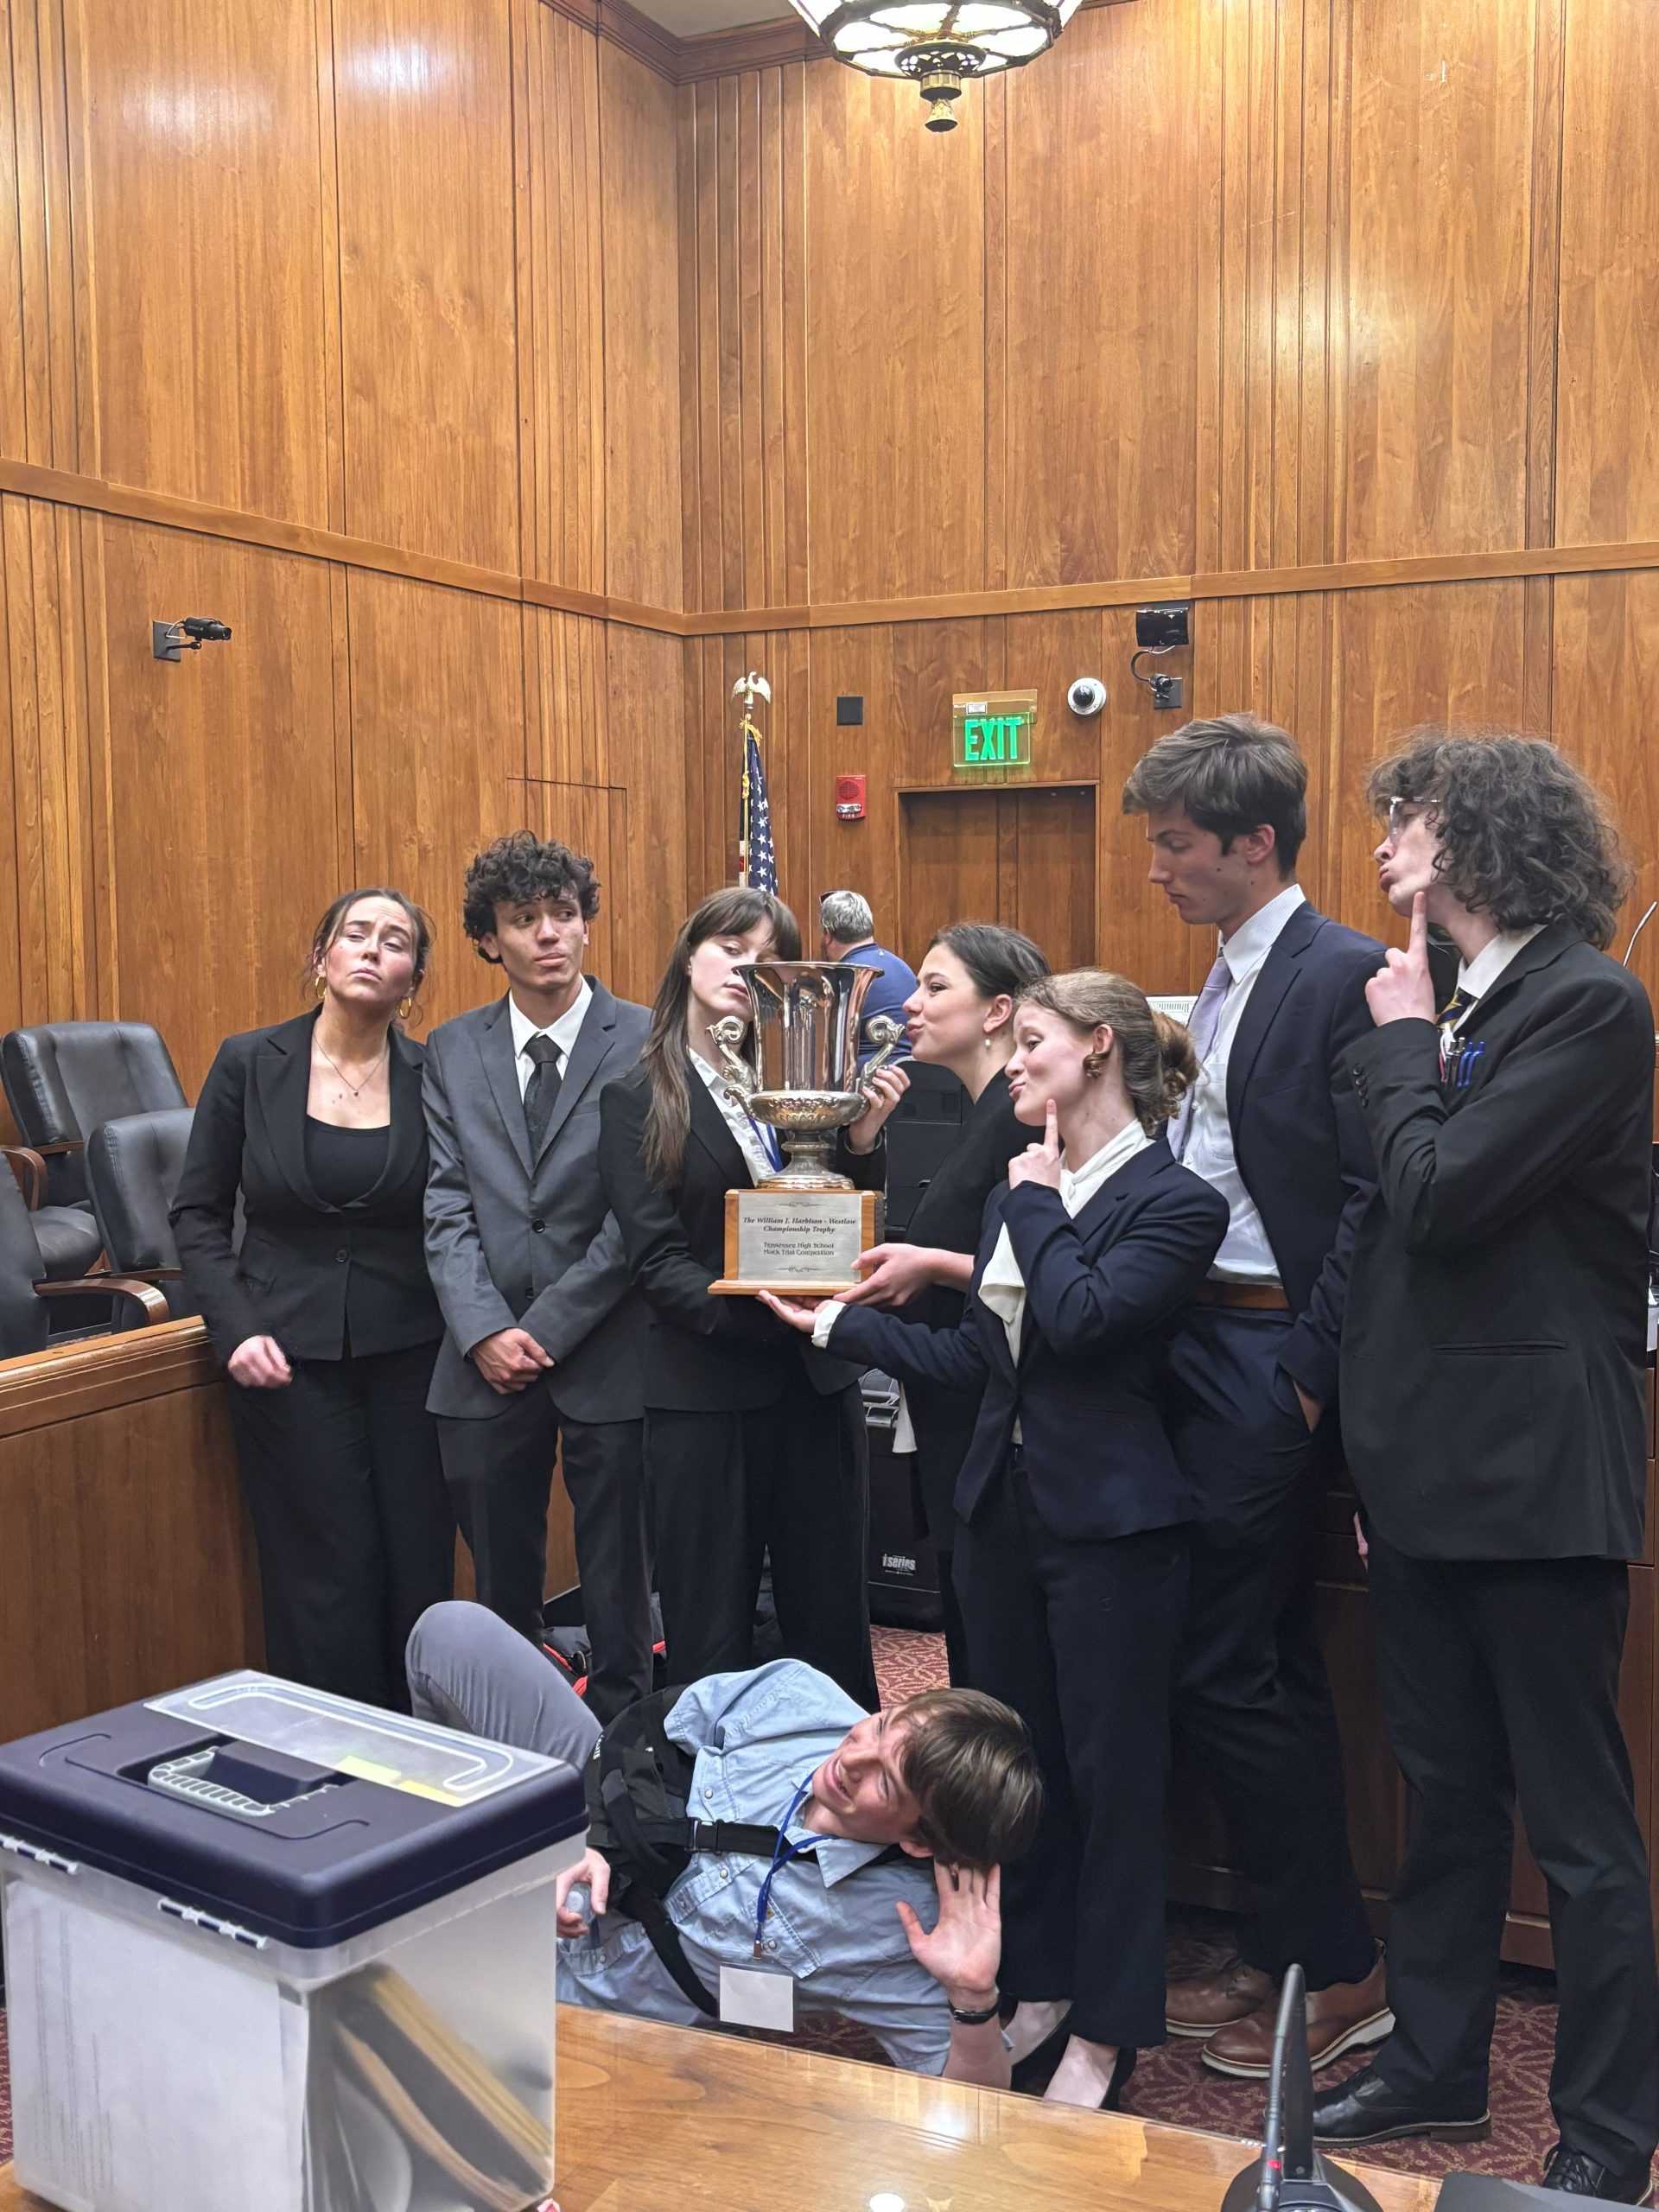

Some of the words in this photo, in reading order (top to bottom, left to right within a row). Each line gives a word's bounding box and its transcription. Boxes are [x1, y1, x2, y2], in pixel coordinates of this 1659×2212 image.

[964, 716, 1024, 761] EXIT
[763, 1225, 810, 1234] Championship
[812, 1225, 836, 1234] Trophy
